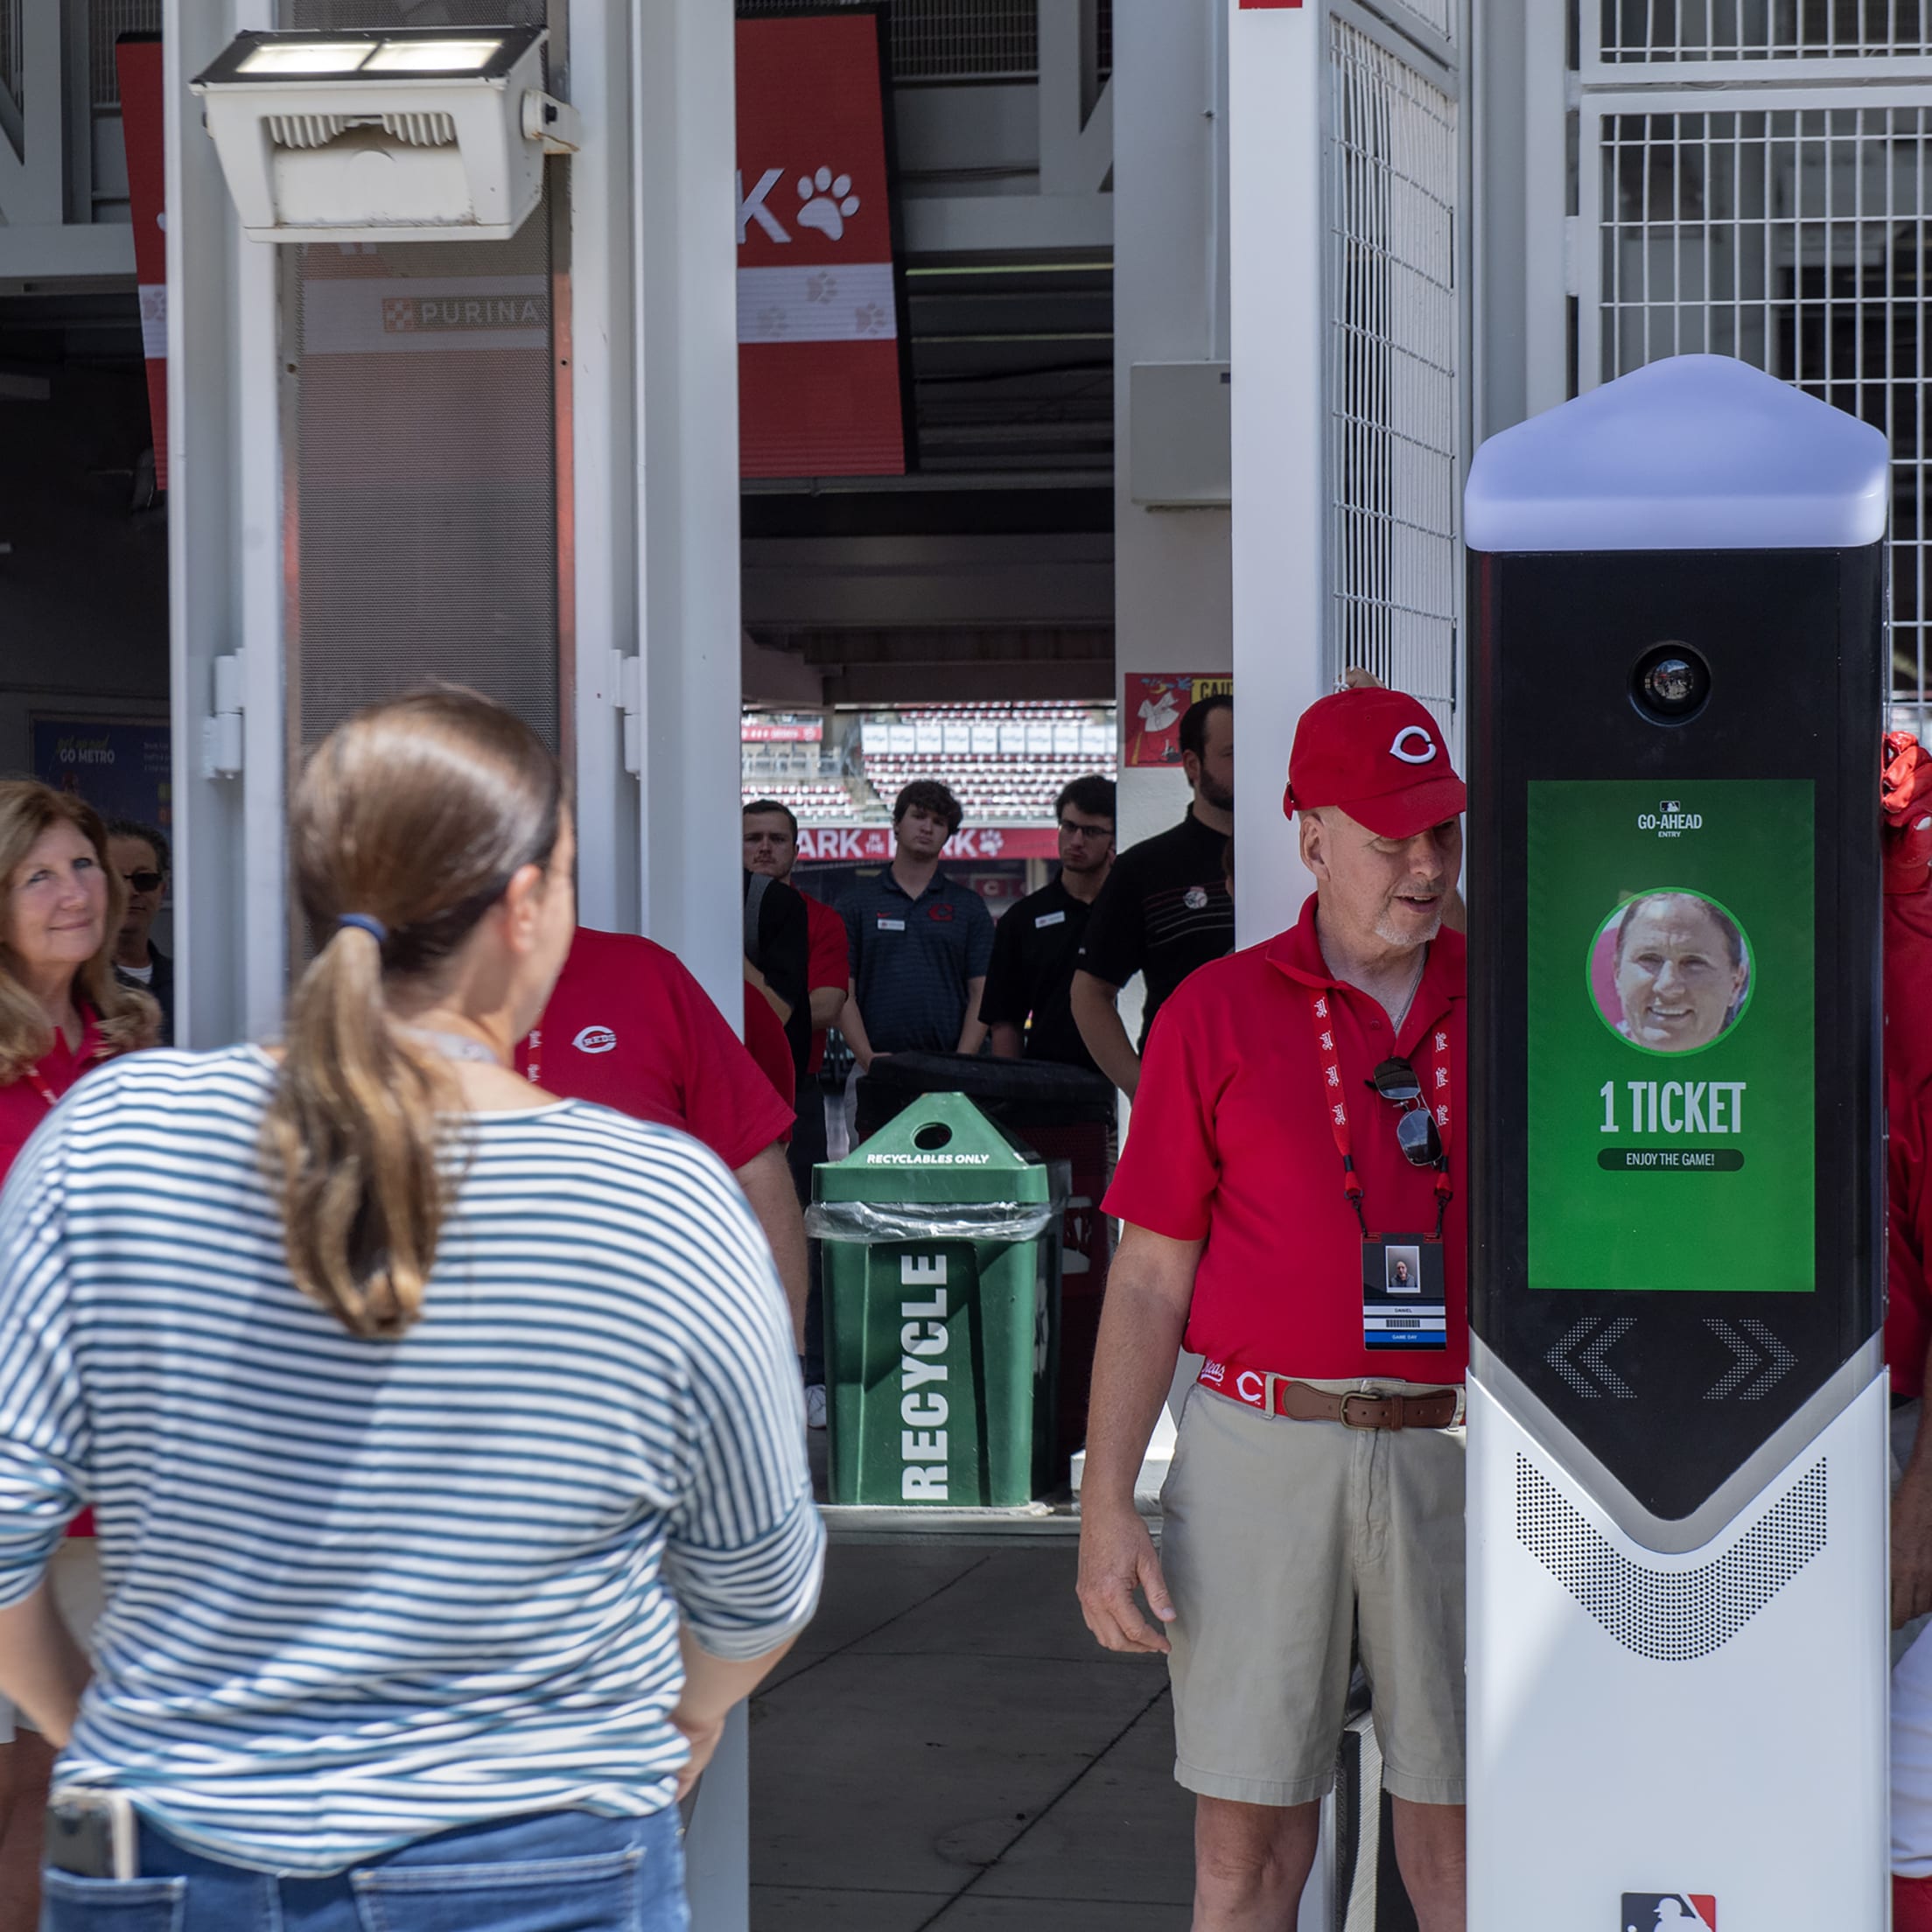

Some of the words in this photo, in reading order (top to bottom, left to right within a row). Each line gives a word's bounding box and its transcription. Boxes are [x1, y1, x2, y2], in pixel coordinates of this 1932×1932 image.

[736, 168, 793, 244] K
[421, 300, 540, 324] PURINA
[1200, 681, 1233, 700] CAU
[60, 748, 76, 764] GO
[78, 748, 116, 764] METRO
[1390, 725, 1437, 764] C
[1637, 814, 1703, 830] GO-AHEAD
[1600, 1081, 1619, 1132] 1
[1628, 1082, 1746, 1133] TICKET
[867, 1154, 953, 1164] RECYCLABLES
[955, 1154, 990, 1164] ONLY
[1626, 1152, 1658, 1166] ENJOY
[1660, 1153, 1680, 1166] THE
[1682, 1153, 1715, 1166] GAME!
[900, 1255, 948, 1501] RECYCLE
[1236, 1370, 1264, 1402] C
